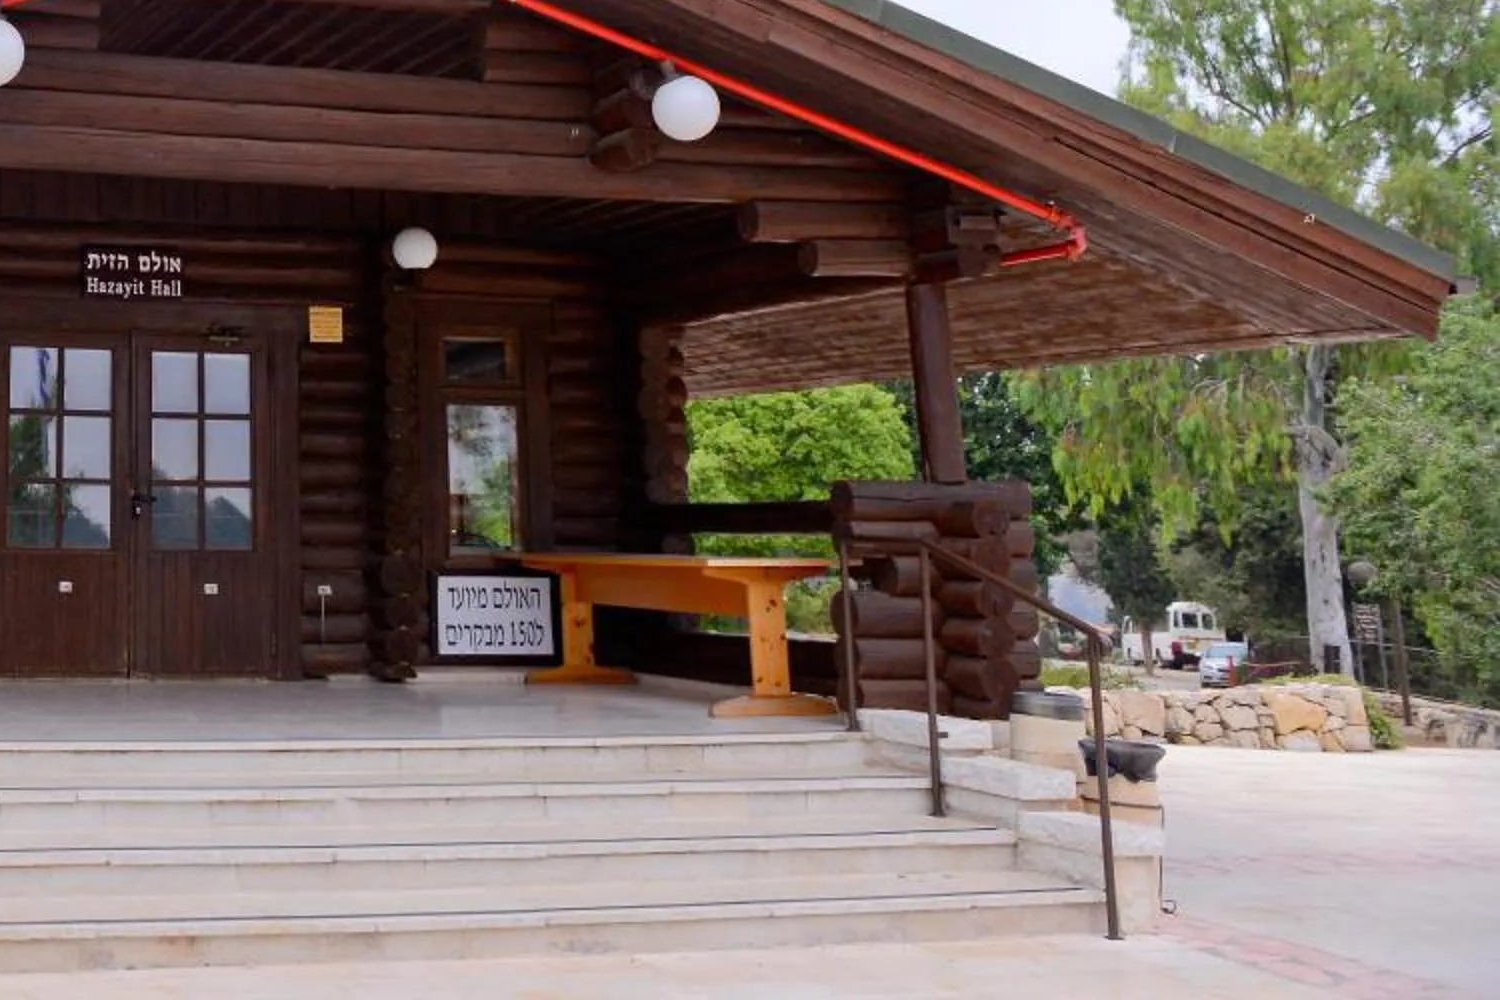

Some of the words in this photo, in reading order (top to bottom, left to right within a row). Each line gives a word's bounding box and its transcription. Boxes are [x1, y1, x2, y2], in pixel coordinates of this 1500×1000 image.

[87, 253, 128, 270] הזית
[138, 250, 181, 272] אולם
[87, 276, 145, 298] Hazayit
[151, 279, 181, 296] Hall
[447, 586, 488, 611] מיועד
[493, 580, 541, 609] האולם
[445, 623, 505, 651] מבקרים
